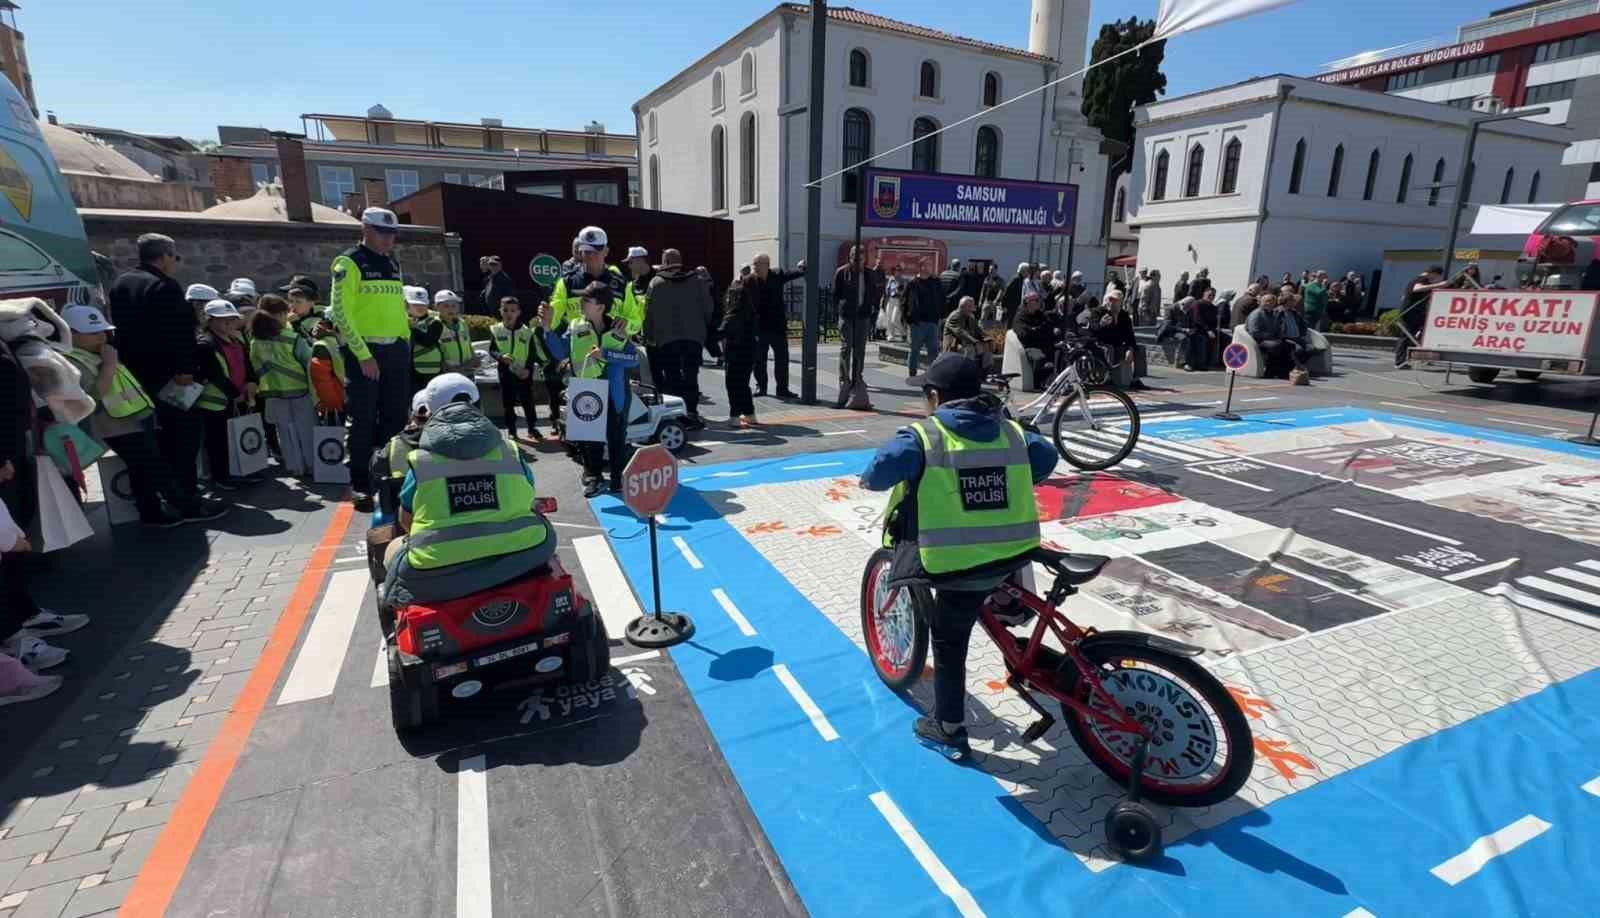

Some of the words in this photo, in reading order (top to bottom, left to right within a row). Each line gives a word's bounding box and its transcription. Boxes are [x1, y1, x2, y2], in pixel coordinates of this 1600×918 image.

[957, 185, 1006, 202] SAMSUN
[912, 198, 922, 219] İL
[924, 202, 980, 223] JANDARMA
[983, 206, 1047, 226] KOMUTANLIĞI
[532, 264, 558, 279] GEÇ
[1450, 293, 1573, 318] DİKKAT!
[1434, 316, 1489, 334] GENİŞ
[1495, 321, 1516, 332] ve
[1523, 320, 1584, 336] UZUN
[1472, 335, 1527, 352] ARAÇ
[448, 479, 496, 493] TRAFİK
[628, 465, 673, 497] STOP
[960, 471, 1005, 489] TRAFİK
[454, 491, 496, 507] POLİSİ
[965, 487, 1005, 505] POLİSİ
[558, 687, 617, 716] yaya
[1114, 671, 1212, 768] MONSTER
